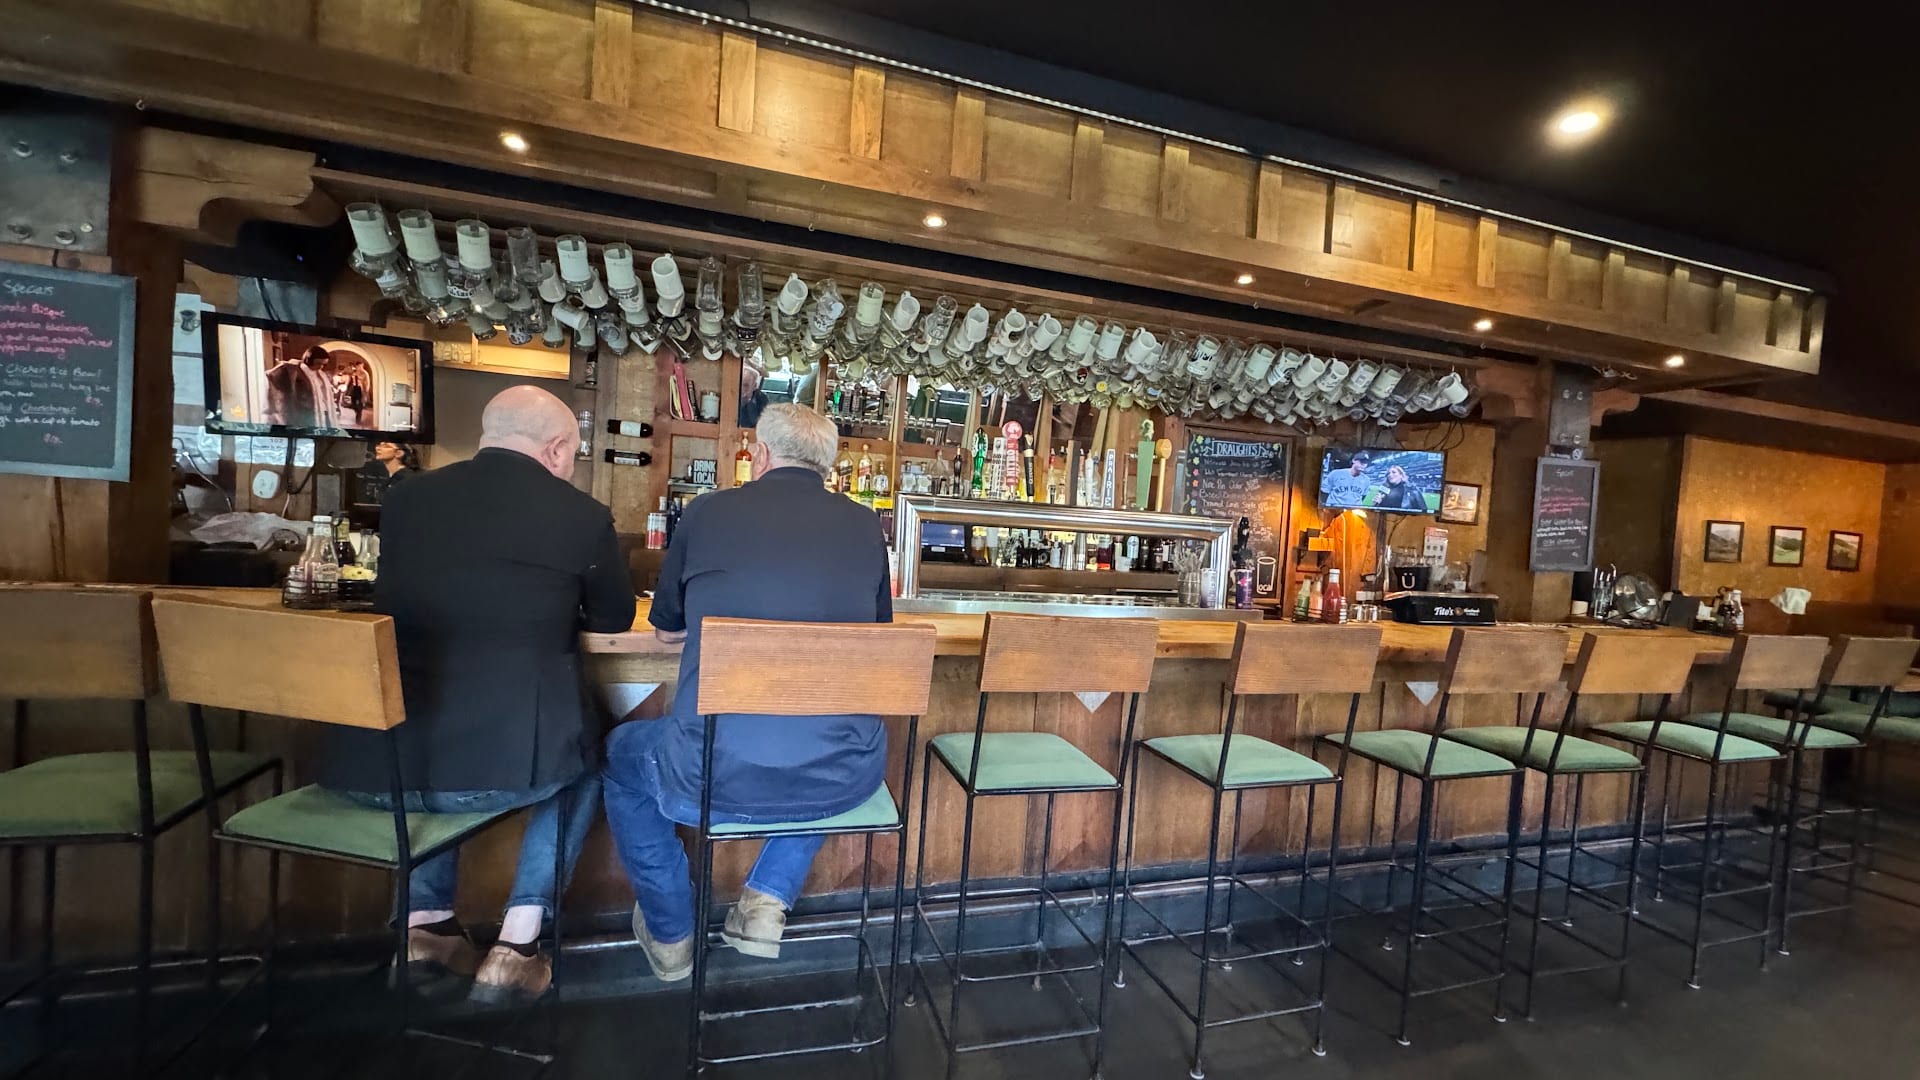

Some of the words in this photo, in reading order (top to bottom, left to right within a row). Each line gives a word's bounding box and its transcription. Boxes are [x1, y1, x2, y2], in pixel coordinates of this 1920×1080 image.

[31, 303, 65, 319] Bisque
[6, 363, 47, 374] Chicken
[1216, 442, 1259, 456] DRAUGHTS
[694, 459, 716, 472] DRINK
[693, 471, 715, 484] LOCAL
[1105, 454, 1114, 507] PRAIRIE
[1433, 606, 1455, 616] Tito's
